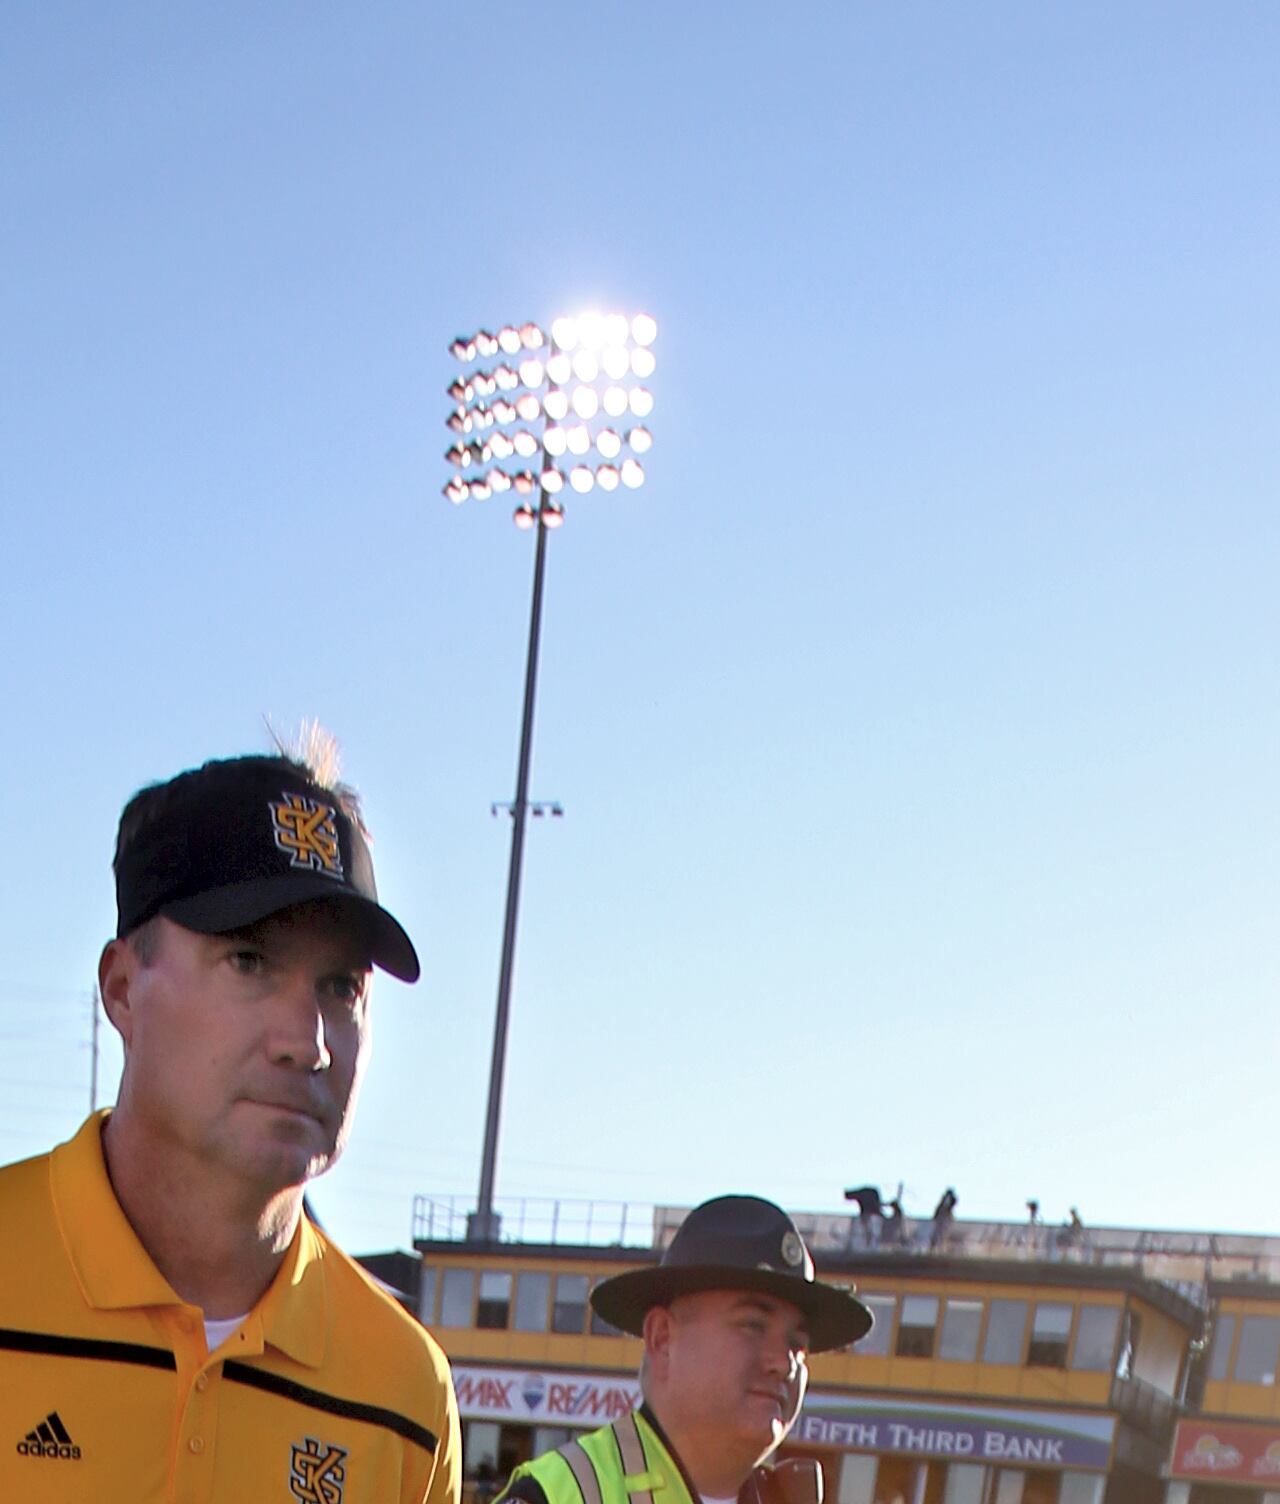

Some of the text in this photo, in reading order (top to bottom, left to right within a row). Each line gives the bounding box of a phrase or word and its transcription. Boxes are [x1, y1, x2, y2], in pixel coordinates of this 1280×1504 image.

[16, 1440, 82, 1460] adidas
[804, 1416, 1067, 1462] FIFTH THIRD BANK
